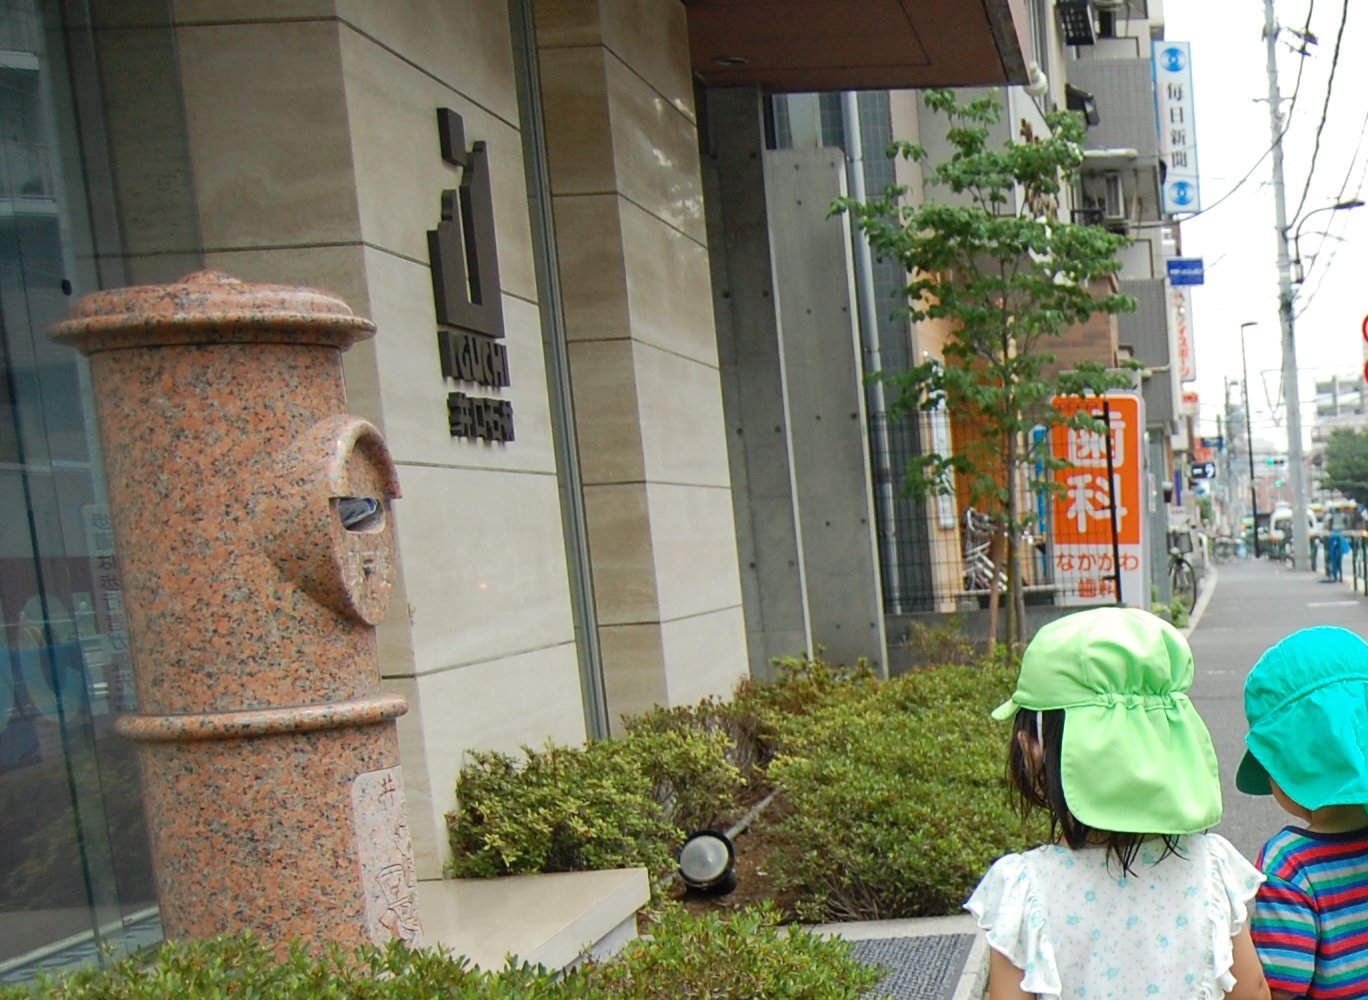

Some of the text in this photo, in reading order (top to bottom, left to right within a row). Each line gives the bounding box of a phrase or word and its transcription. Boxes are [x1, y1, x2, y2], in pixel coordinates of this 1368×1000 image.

[1167, 82, 1188, 169] 毎日新聞
[437, 331, 510, 387] IGUCHI
